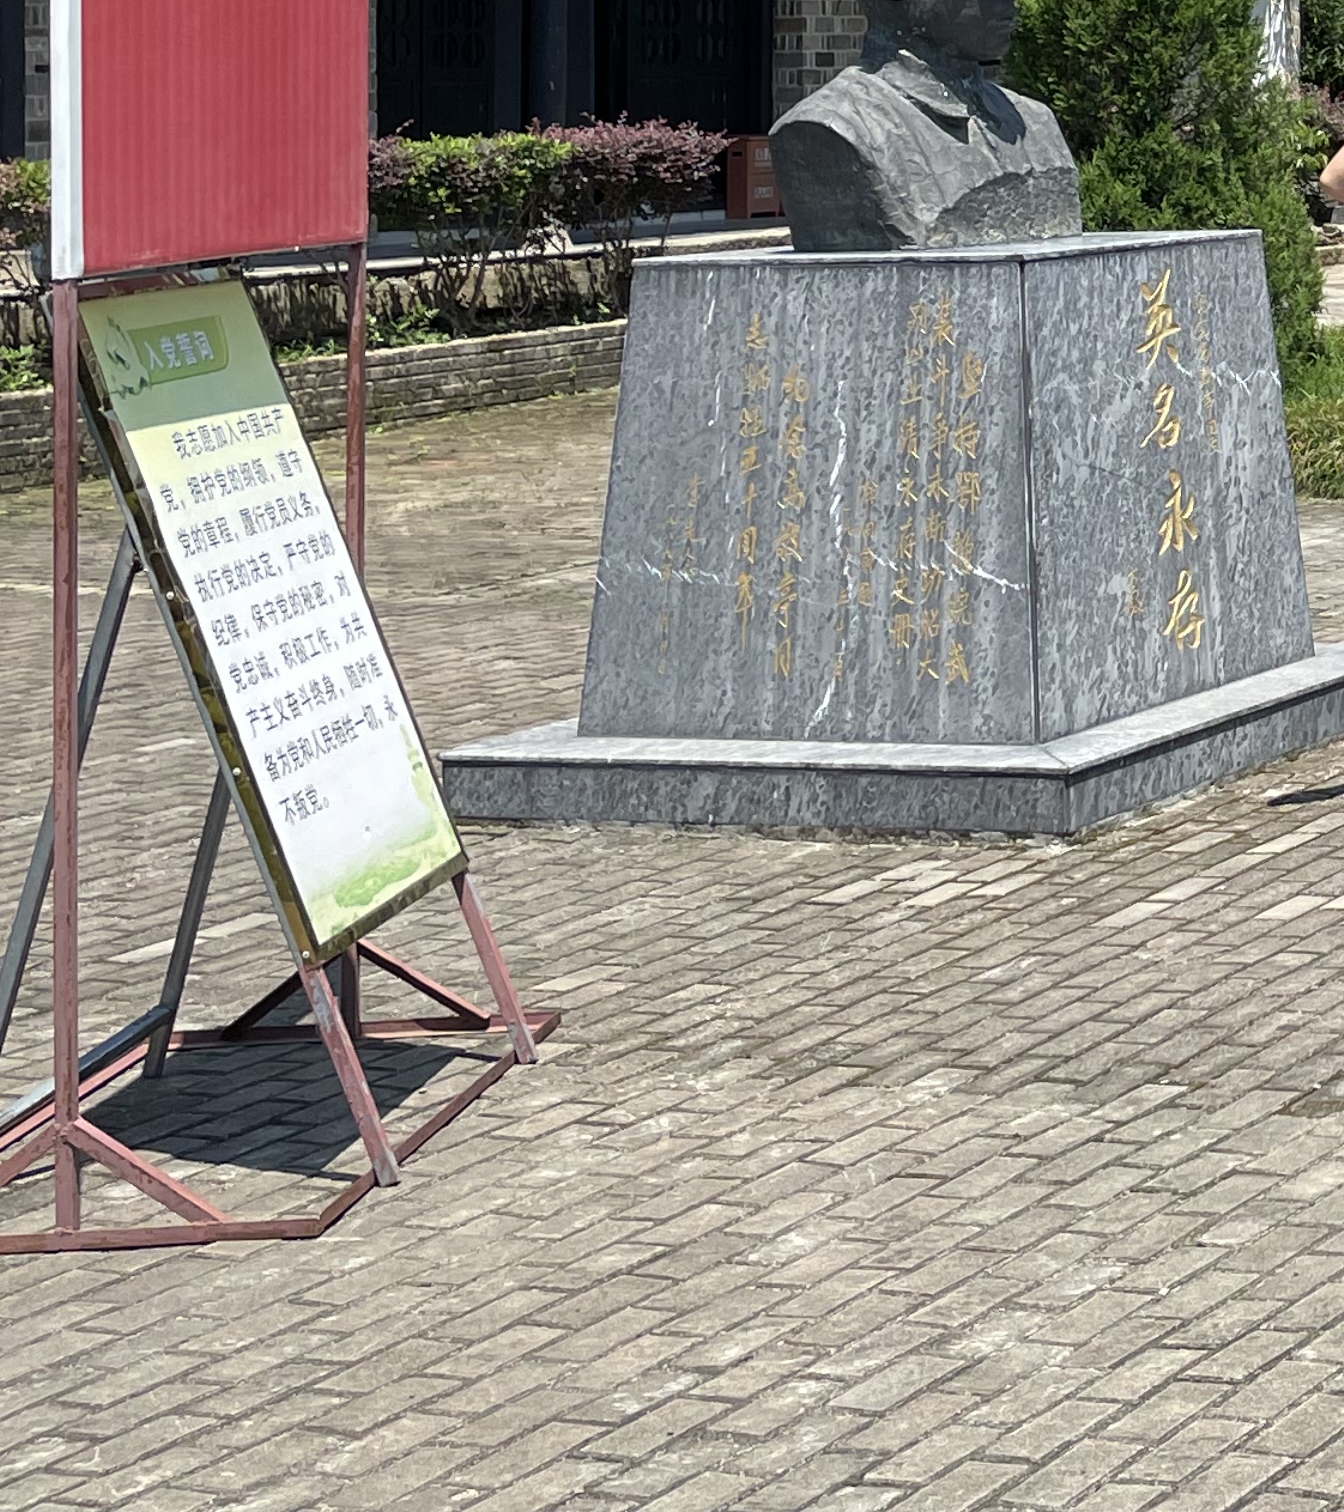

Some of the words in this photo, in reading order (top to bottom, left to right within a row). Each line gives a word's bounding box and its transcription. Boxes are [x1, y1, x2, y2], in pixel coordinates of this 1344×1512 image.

[144, 330, 214, 371] 入党誓词
[171, 408, 284, 459] 我志愿加入中国共产
[1136, 269, 1206, 653] 英名永存
[279, 784, 330, 826] 不叛党。
